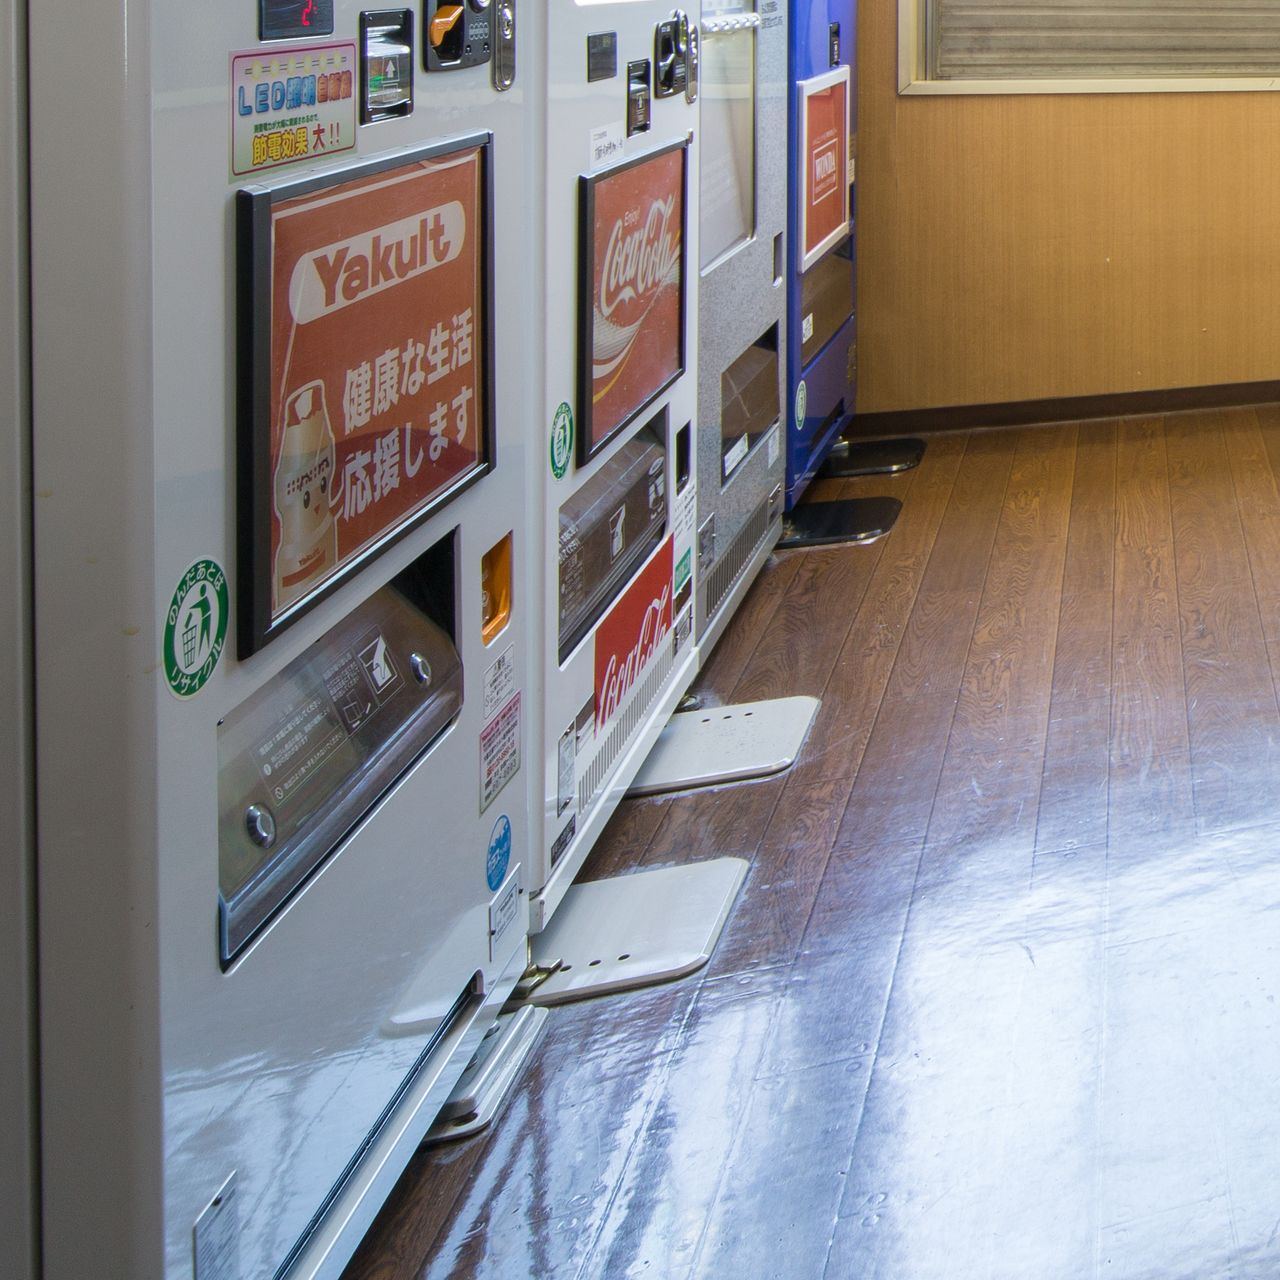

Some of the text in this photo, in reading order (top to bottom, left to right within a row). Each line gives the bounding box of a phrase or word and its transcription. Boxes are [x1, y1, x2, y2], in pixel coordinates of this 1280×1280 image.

[252, 126, 308, 166] 節電効果
[312, 212, 451, 307] Yakult
[601, 193, 676, 318] Coca-Cola
[341, 308, 473, 437] 健康な生活
[342, 385, 473, 522] 応援します
[169, 563, 224, 626] のんだあとは
[171, 637, 222, 694] リサイクル
